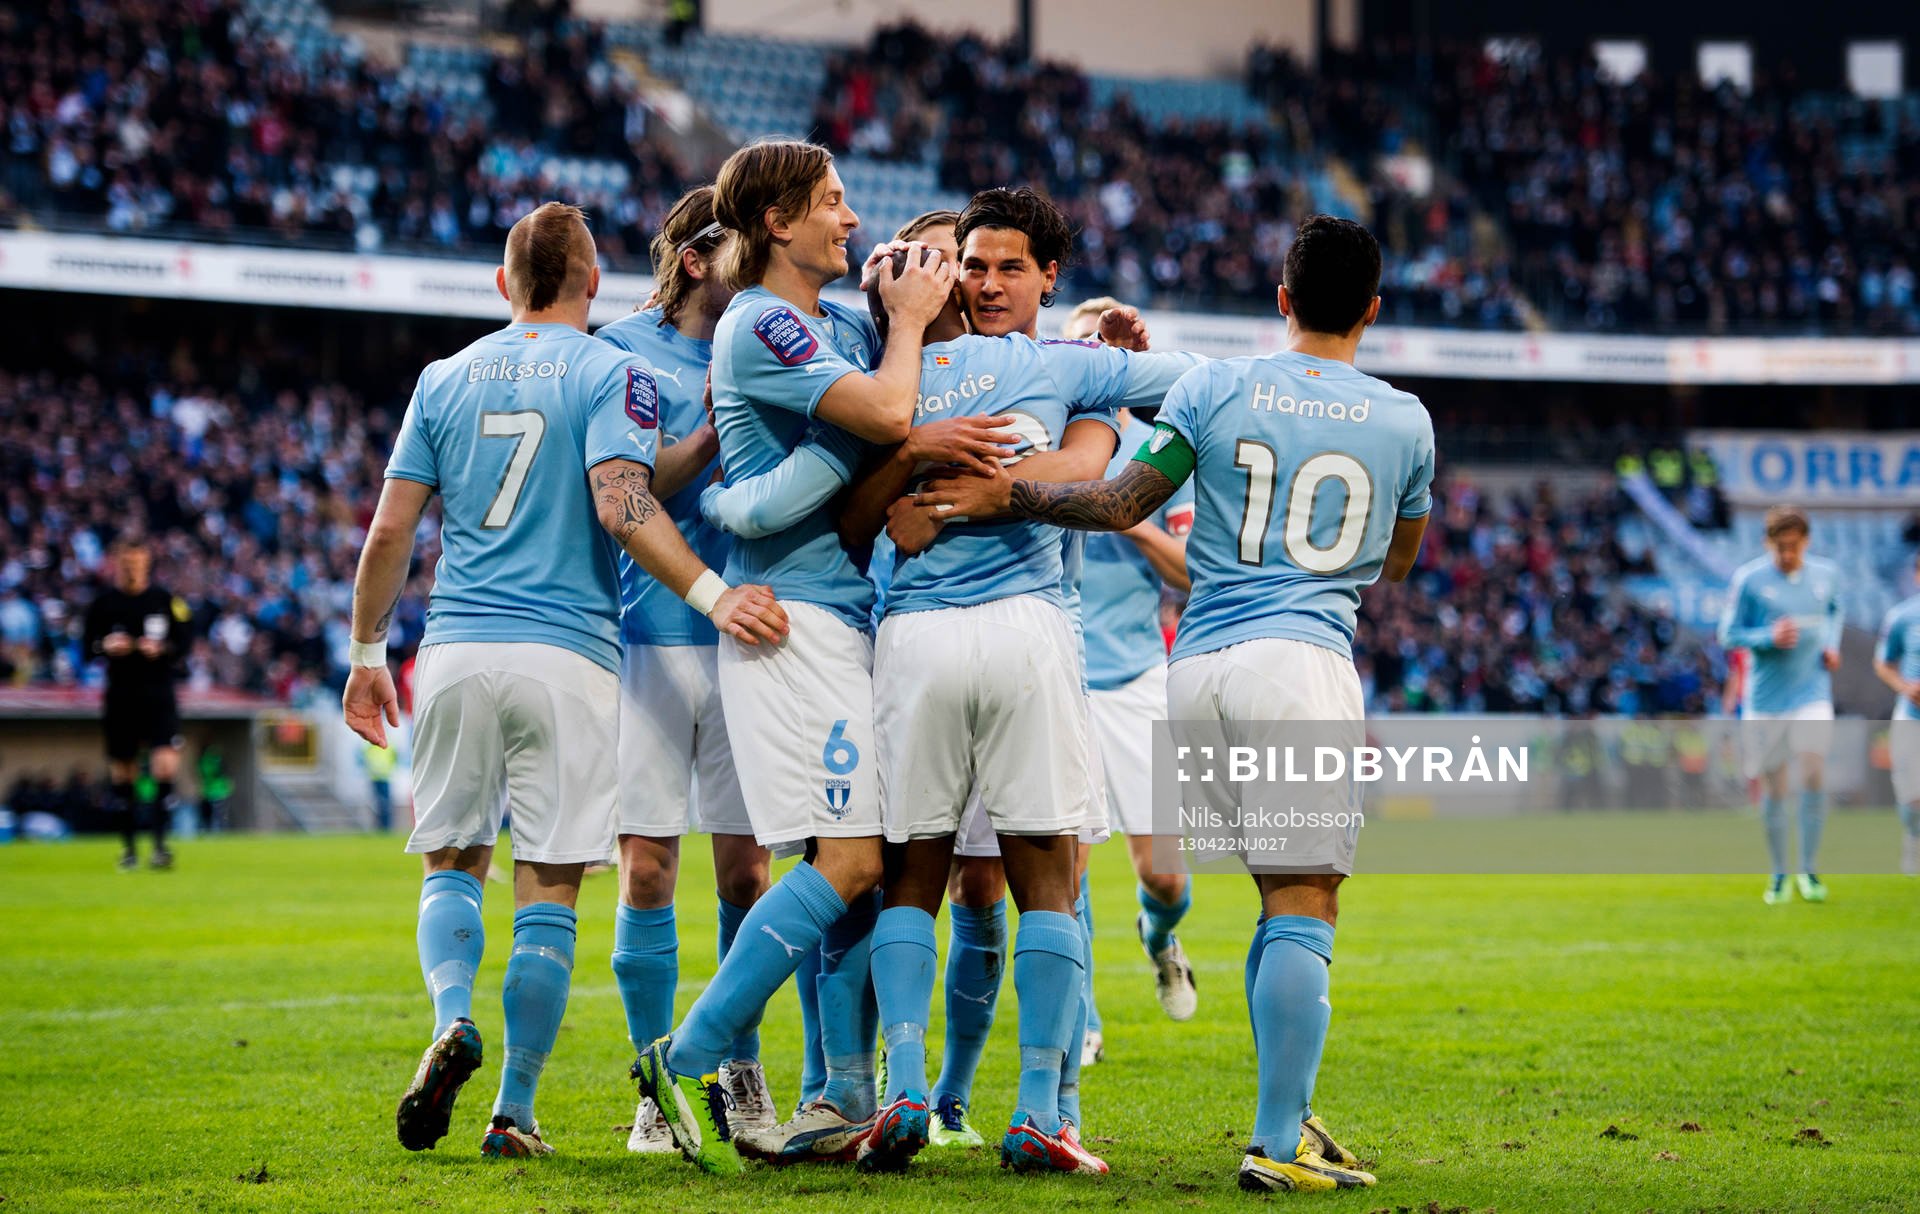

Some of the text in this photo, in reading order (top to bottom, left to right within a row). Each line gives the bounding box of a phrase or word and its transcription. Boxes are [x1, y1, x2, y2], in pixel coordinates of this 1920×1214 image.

[768, 316, 785, 330] HELA
[467, 355, 568, 384] Eriksson
[1251, 382, 1371, 423] Hamad
[479, 408, 548, 530] 7
[1233, 437, 1375, 576] 10
[822, 719, 860, 776] 6
